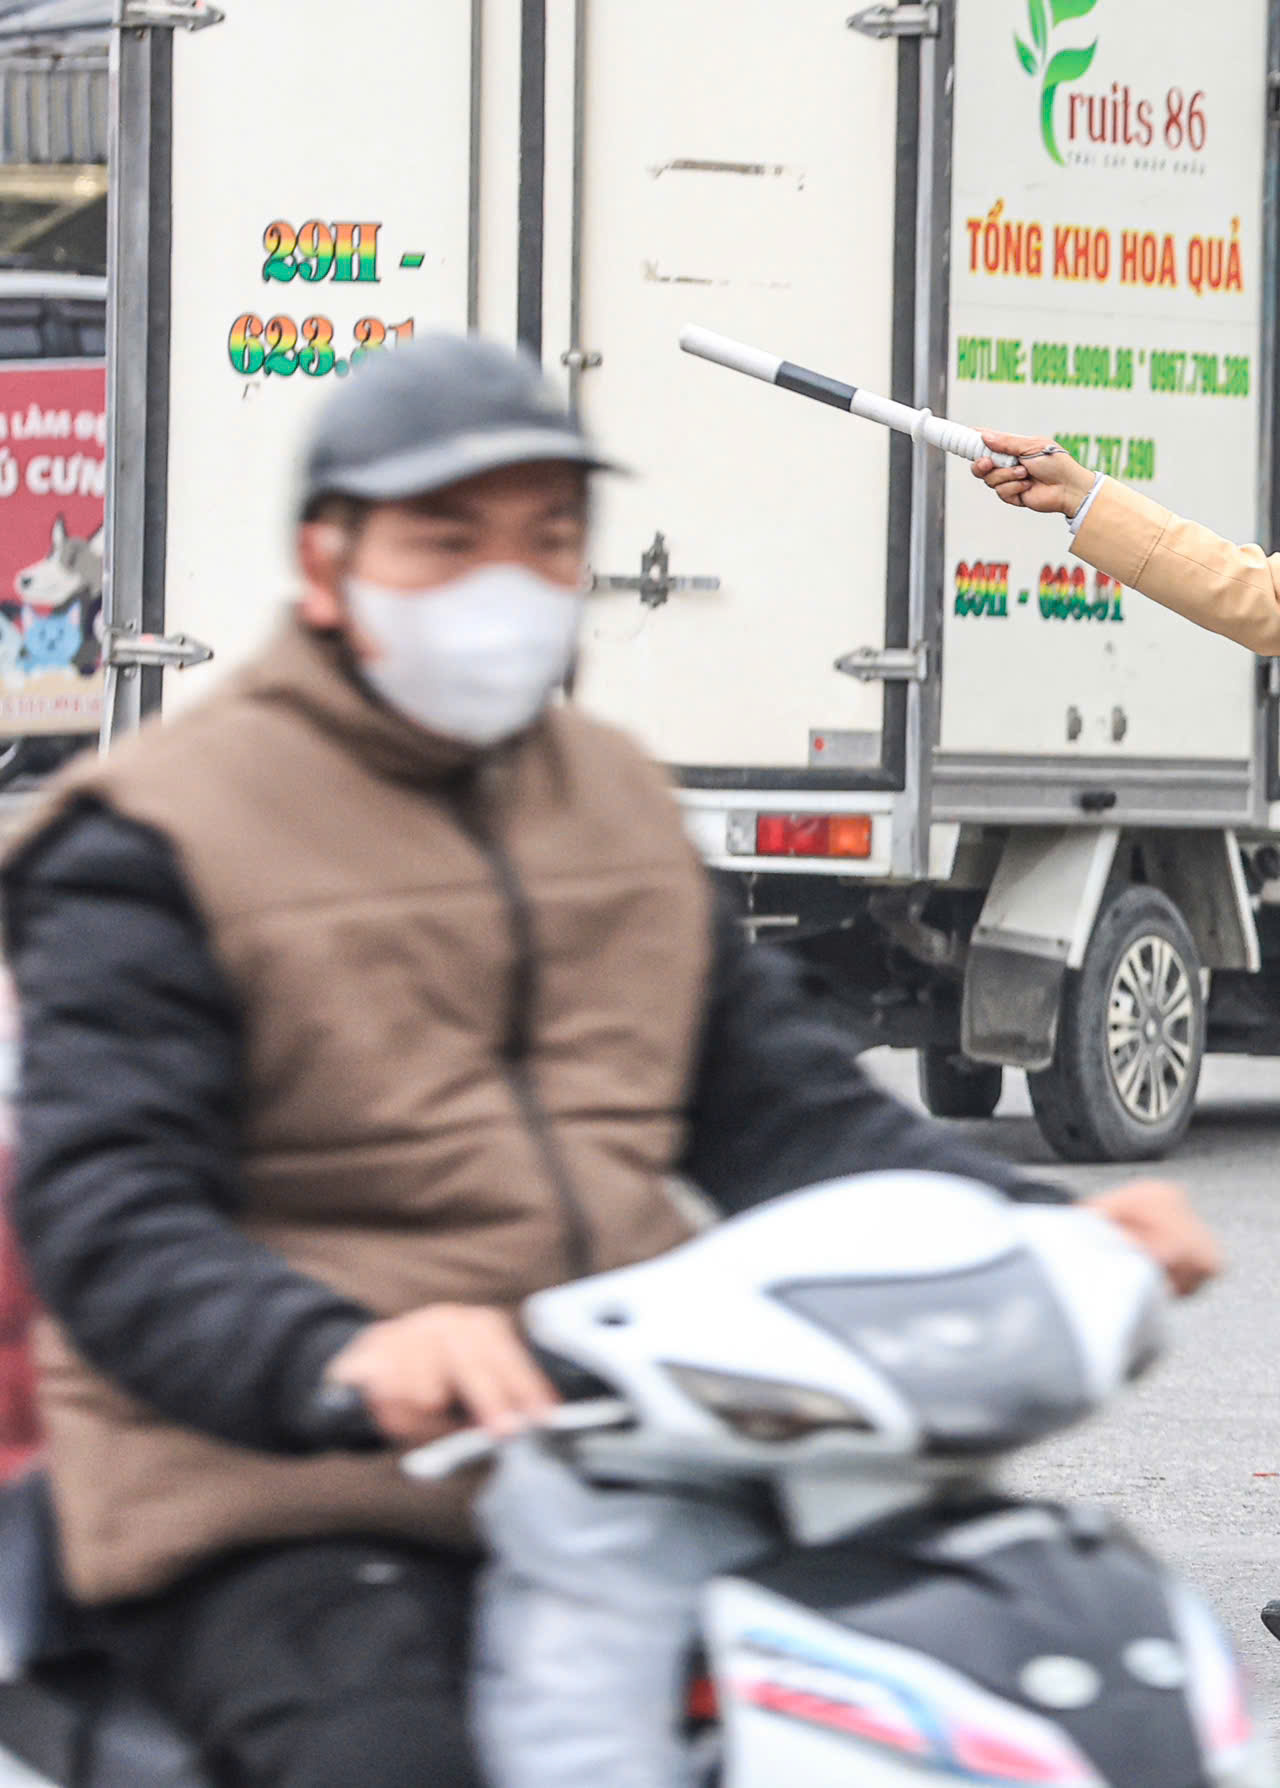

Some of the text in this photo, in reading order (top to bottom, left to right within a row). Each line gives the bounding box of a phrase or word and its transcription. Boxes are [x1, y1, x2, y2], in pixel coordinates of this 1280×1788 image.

[1164, 86, 1208, 152] 86
[261, 219, 426, 283] 29H -
[966, 197, 1244, 297] TỔNG KHO HOA QUẢ
